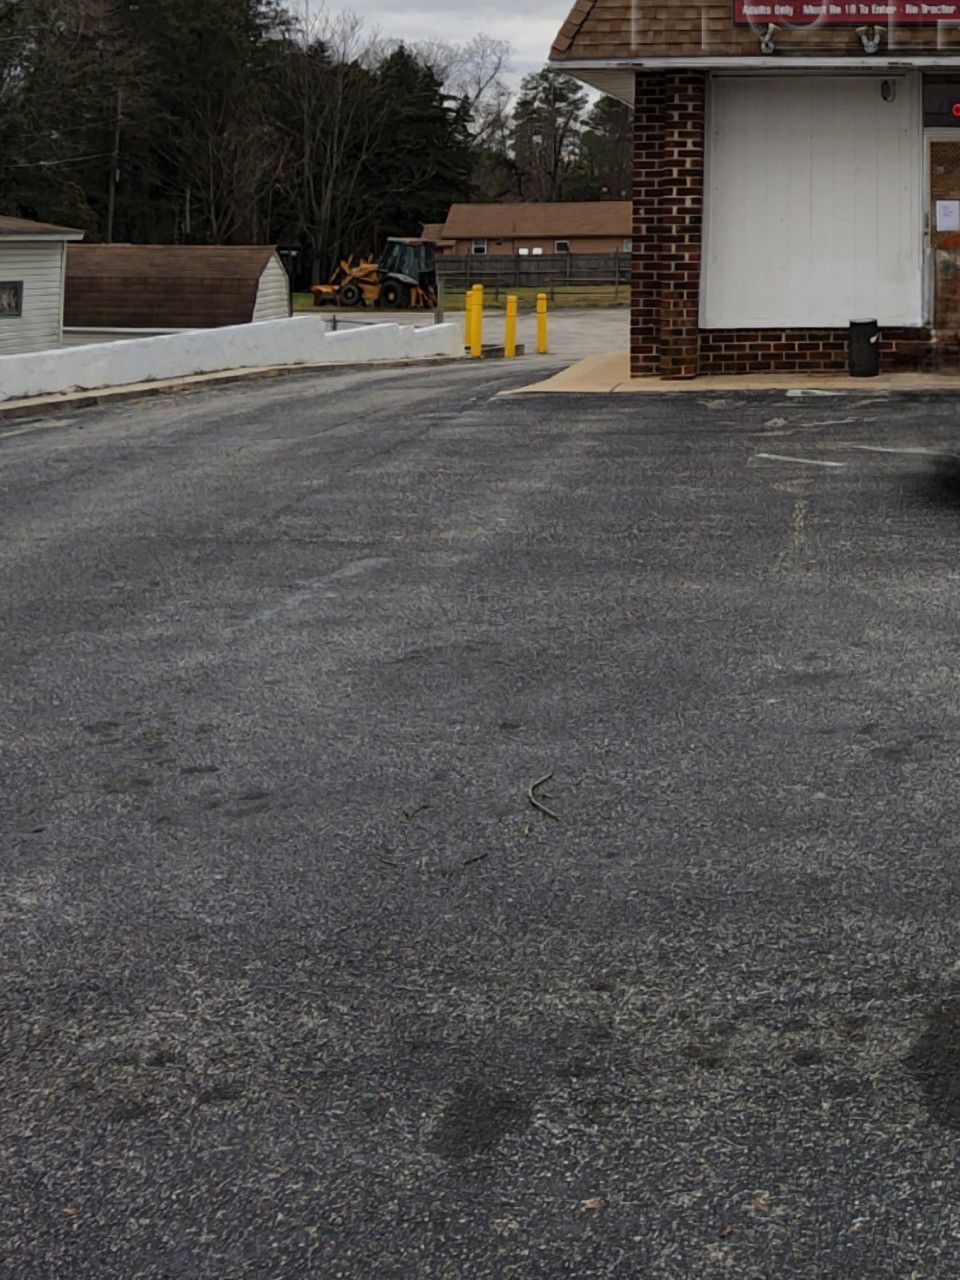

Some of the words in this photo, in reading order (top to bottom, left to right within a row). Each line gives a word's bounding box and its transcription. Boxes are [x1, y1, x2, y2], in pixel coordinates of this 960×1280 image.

[742, 4, 771, 15] Adults
[774, 4, 794, 17] Only
[802, 4, 827, 15] Must
[829, 4, 842, 15] Be
[845, 4, 856, 15] 18
[860, 4, 869, 15] To
[872, 4, 897, 15] Enter
[905, 4, 918, 15] No
[921, 4, 956, 15] Tractor
